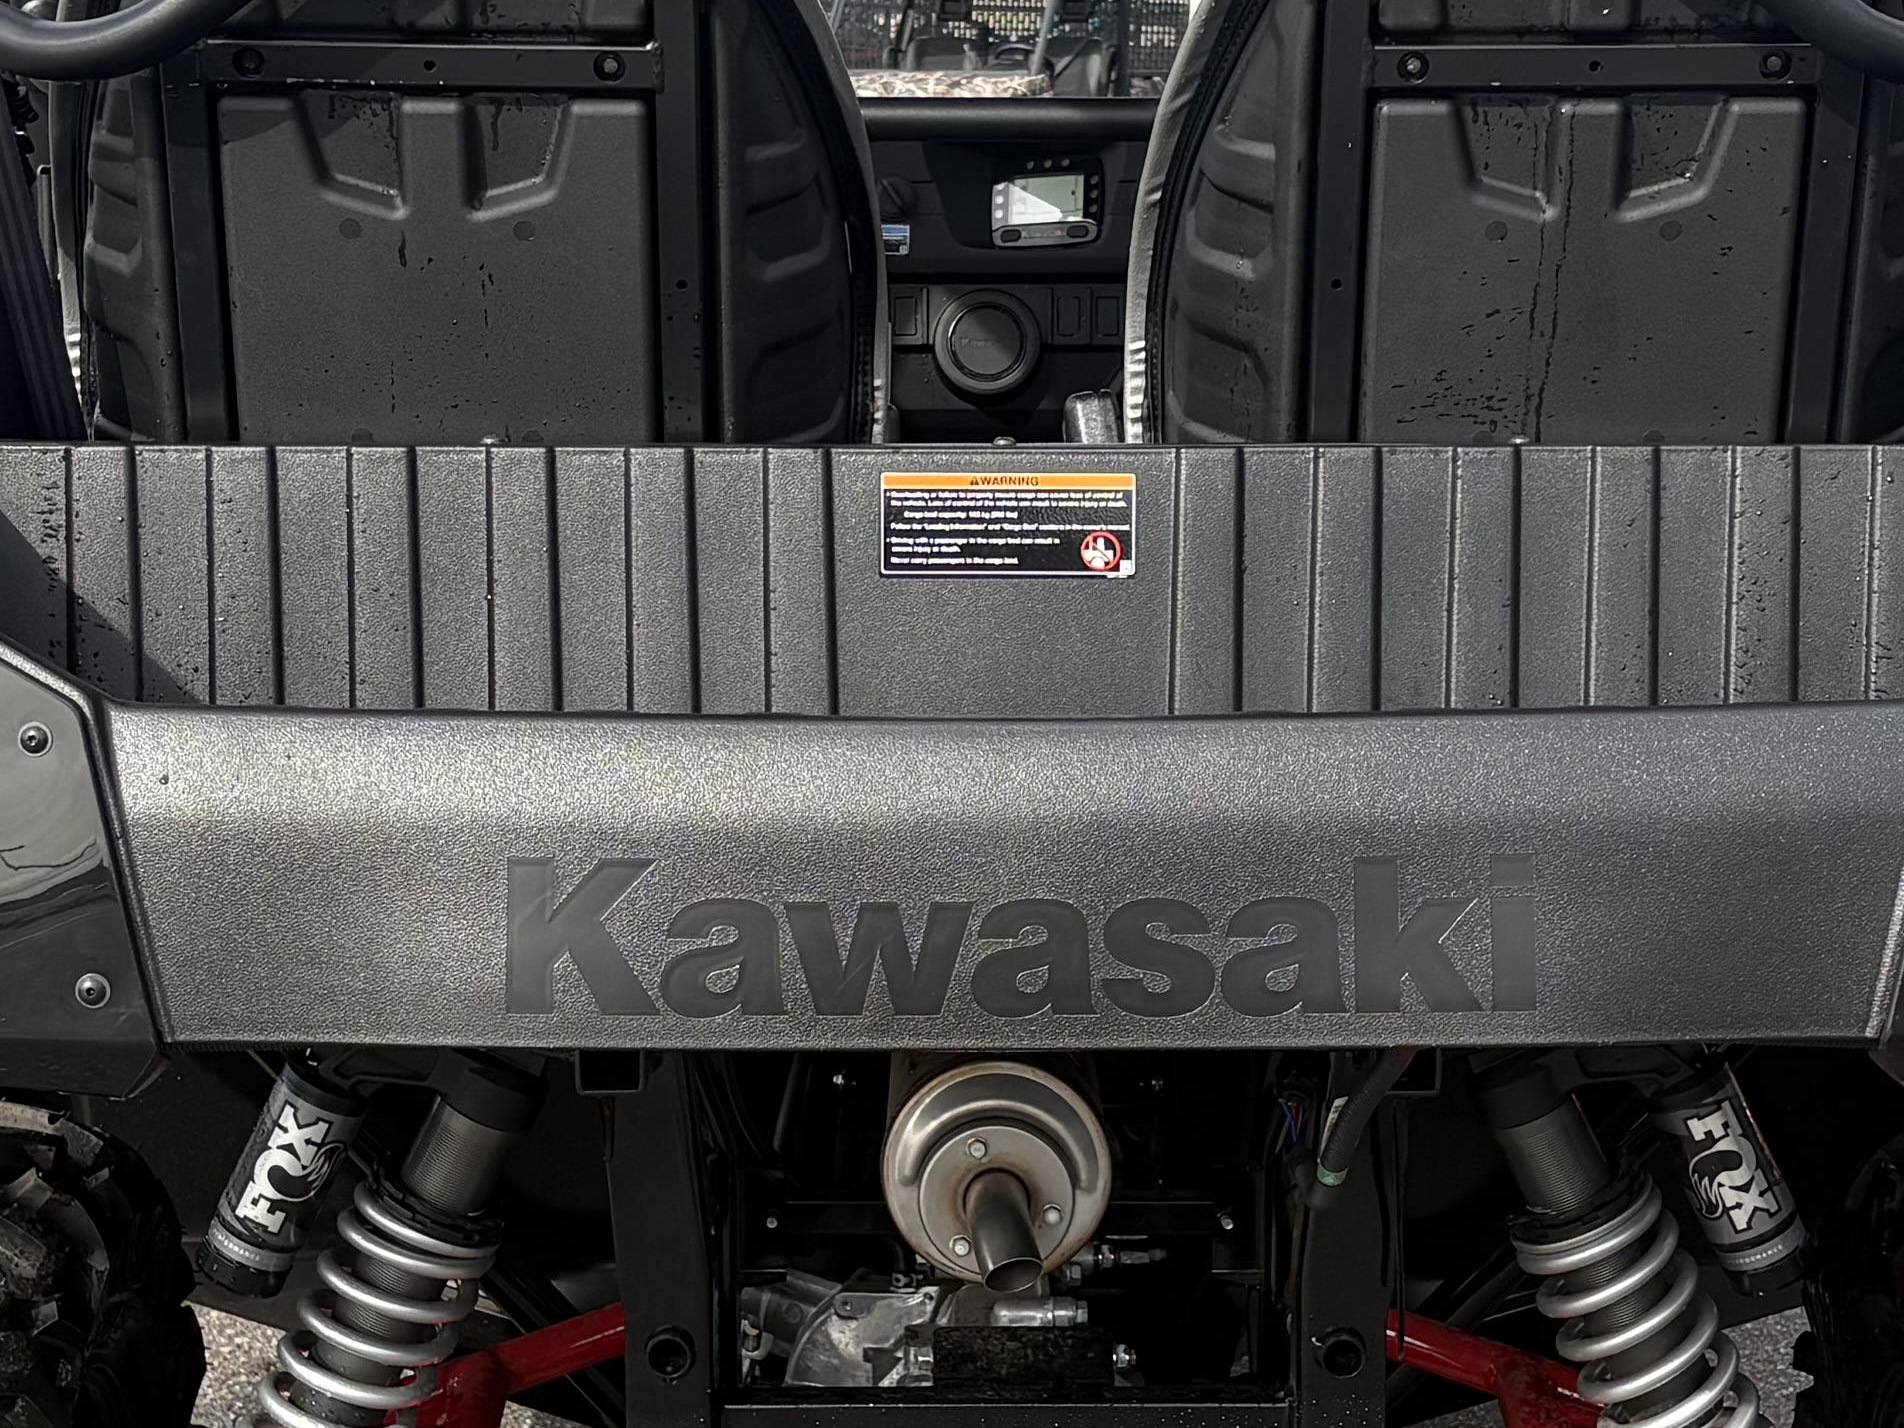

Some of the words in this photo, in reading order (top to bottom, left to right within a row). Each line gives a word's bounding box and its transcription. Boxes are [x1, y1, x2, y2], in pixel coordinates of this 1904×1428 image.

[980, 476, 1039, 486] WARNING
[507, 853, 1538, 1019] Kawasaki
[235, 1103, 332, 1235] FOX
[1686, 1100, 1781, 1232] FOX
